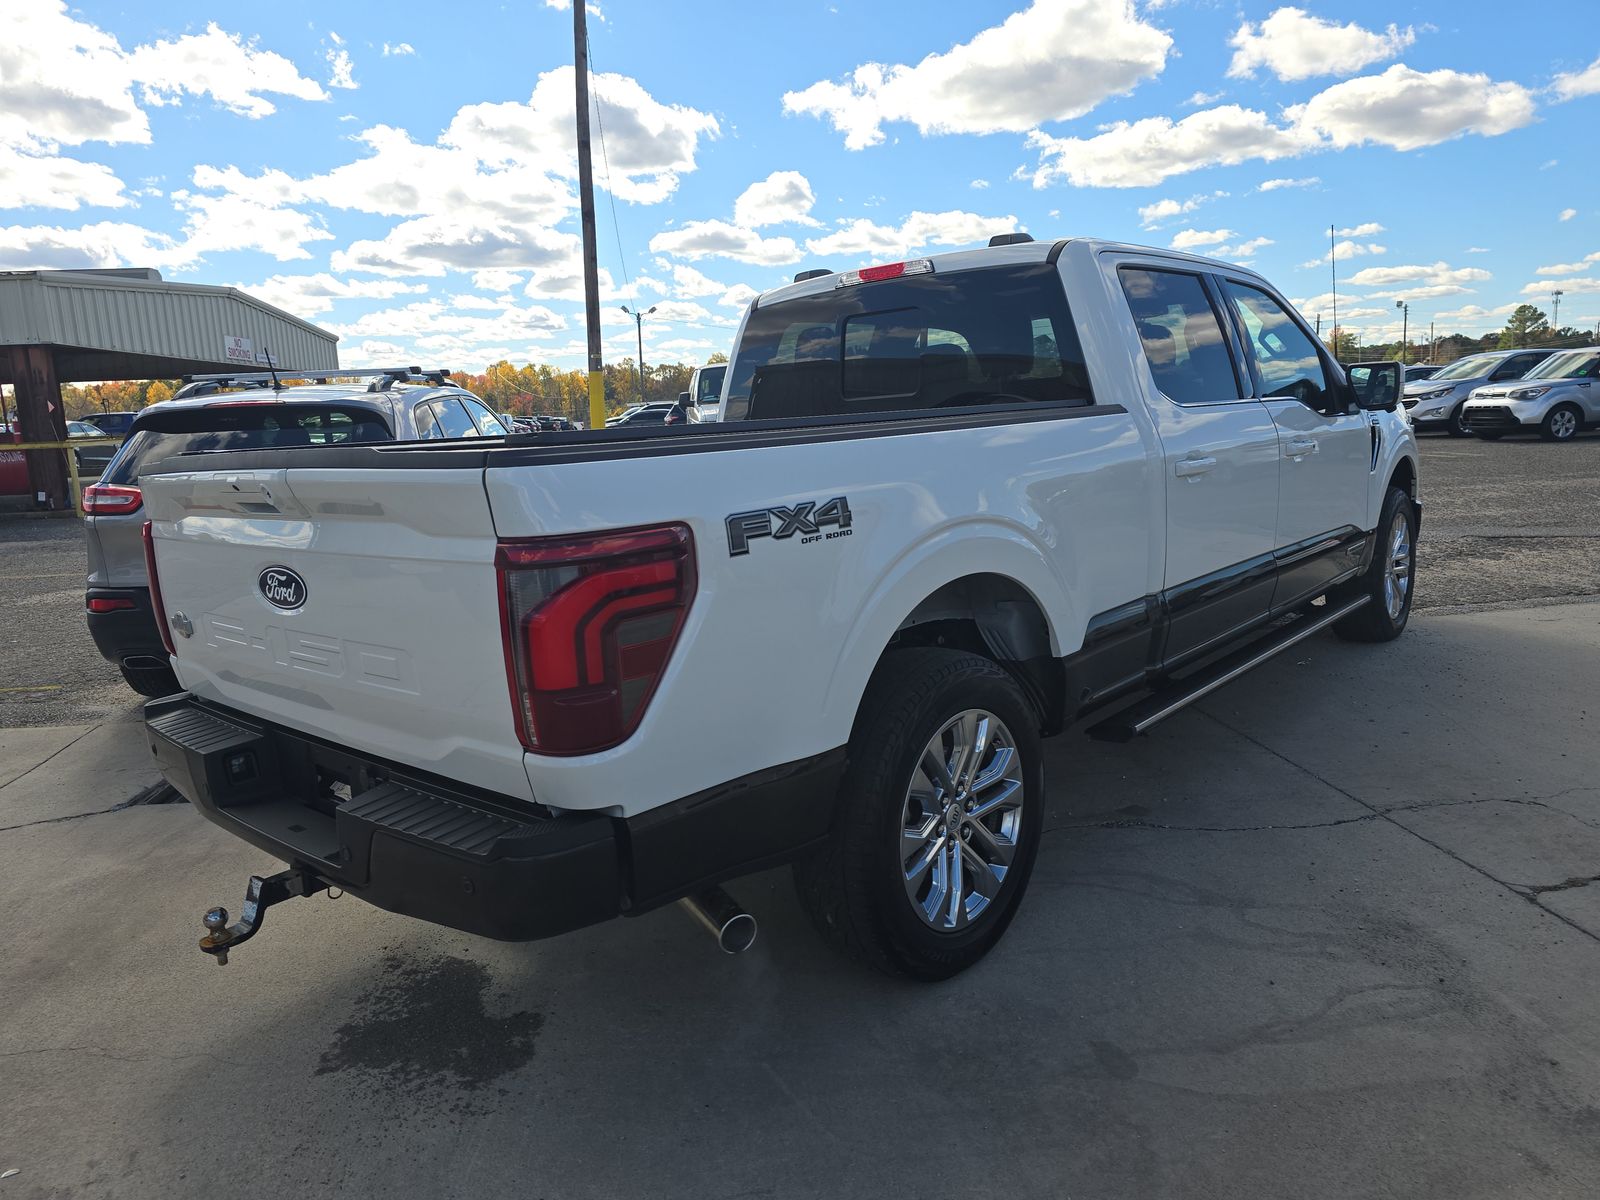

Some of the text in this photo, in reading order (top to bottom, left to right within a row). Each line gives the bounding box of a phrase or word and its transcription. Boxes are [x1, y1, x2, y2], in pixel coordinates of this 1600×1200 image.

[228, 346, 251, 359] SMOKING
[234, 338, 242, 348] NO
[724, 496, 853, 558] FX4
[801, 529, 853, 545] OFF ROAD
[266, 572, 297, 603] Ford
[202, 611, 421, 696] F-150
